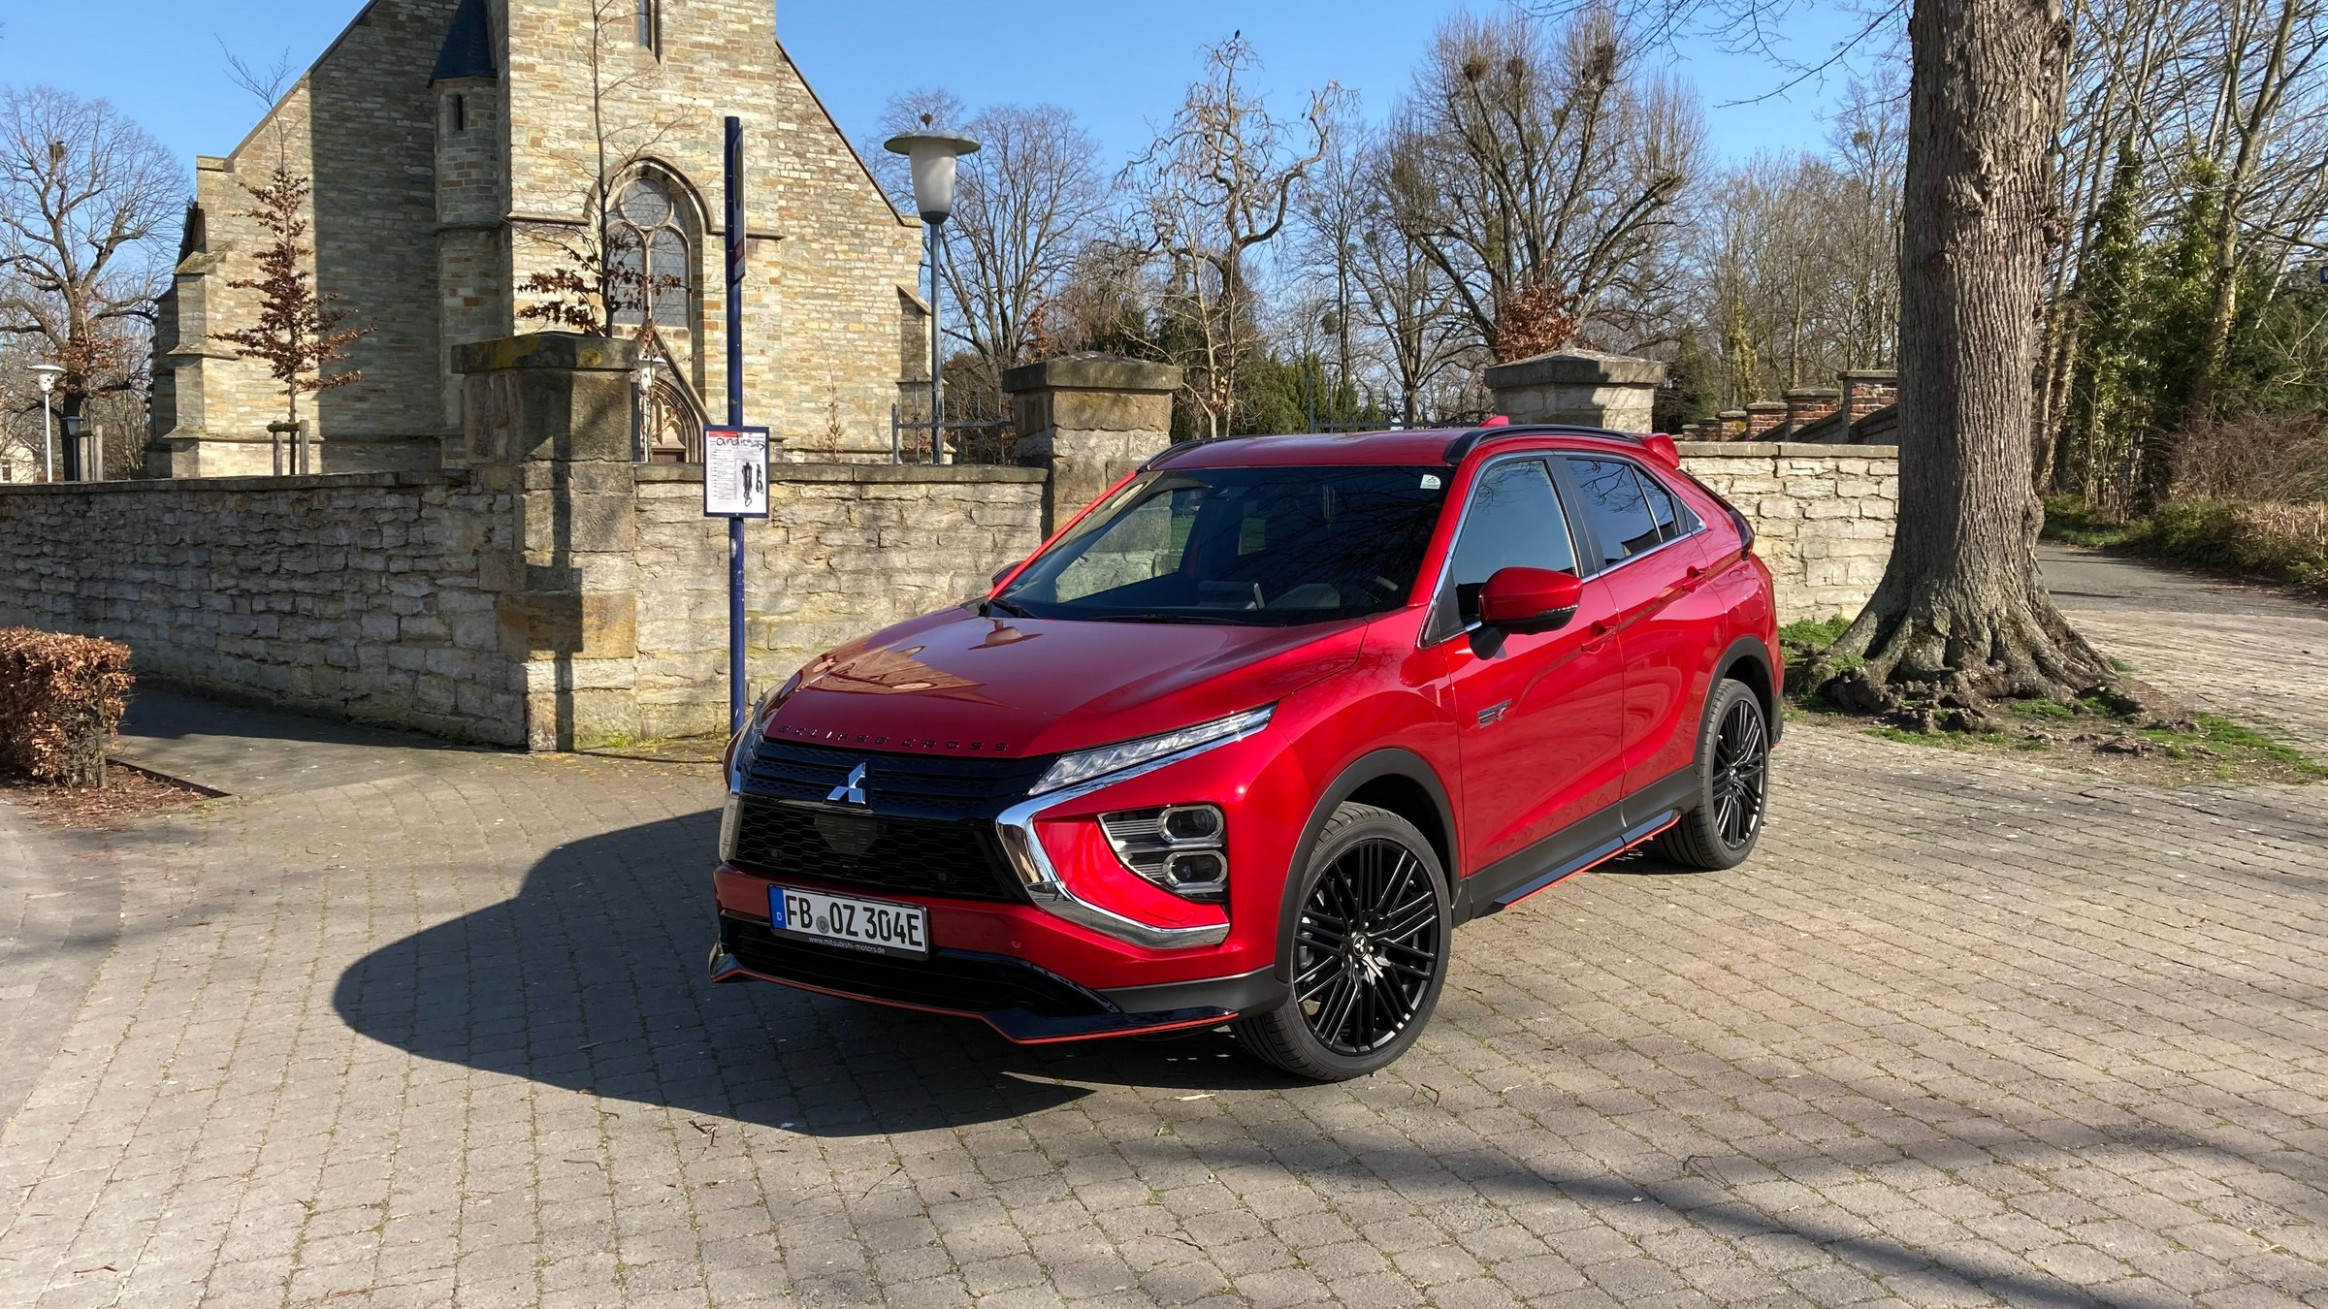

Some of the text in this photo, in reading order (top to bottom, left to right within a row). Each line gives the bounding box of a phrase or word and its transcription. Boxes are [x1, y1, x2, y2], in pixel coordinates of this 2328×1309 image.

[779, 725, 1009, 752] ECLIPSE CROSS
[776, 911, 783, 921] D
[785, 894, 923, 947] FB OZ 304E
[808, 935, 886, 955] www.mitsubishi-motors.de
